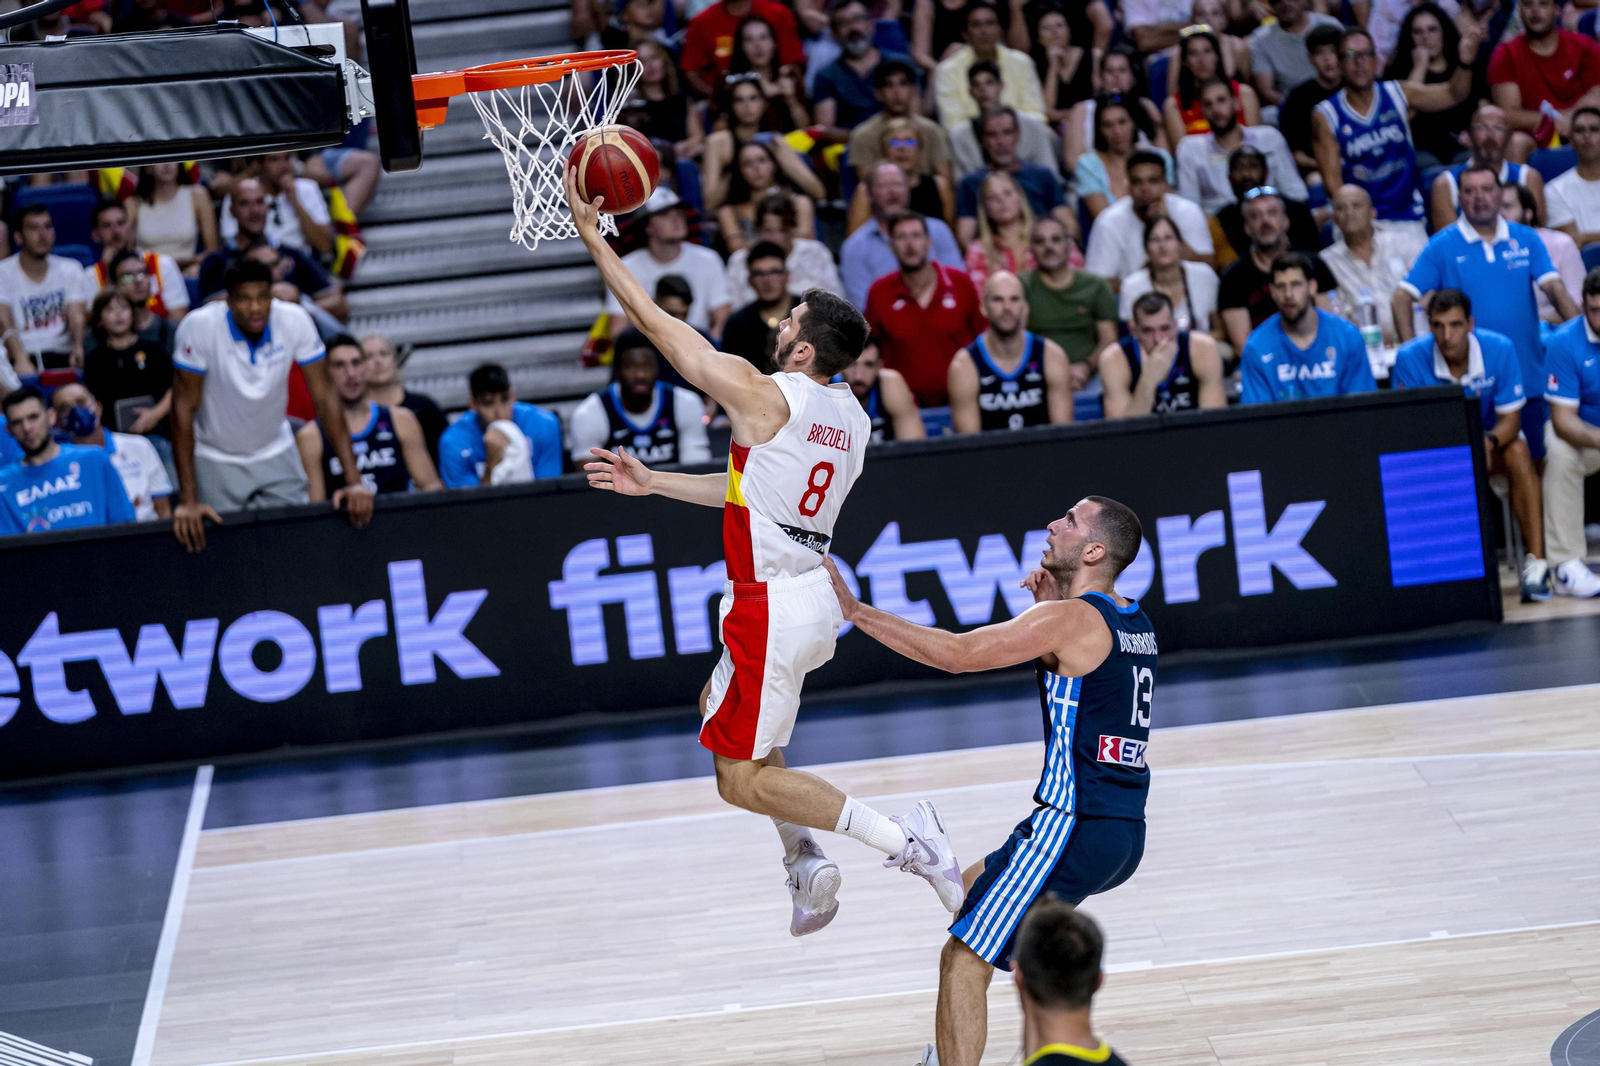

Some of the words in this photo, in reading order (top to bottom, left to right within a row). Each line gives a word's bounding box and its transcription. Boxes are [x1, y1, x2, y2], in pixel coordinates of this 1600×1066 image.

[619, 170, 636, 205] molten
[798, 460, 835, 518] 8
[548, 470, 1337, 666] fintwrk
[0, 559, 501, 728] twork
[1130, 665, 1154, 728] 13
